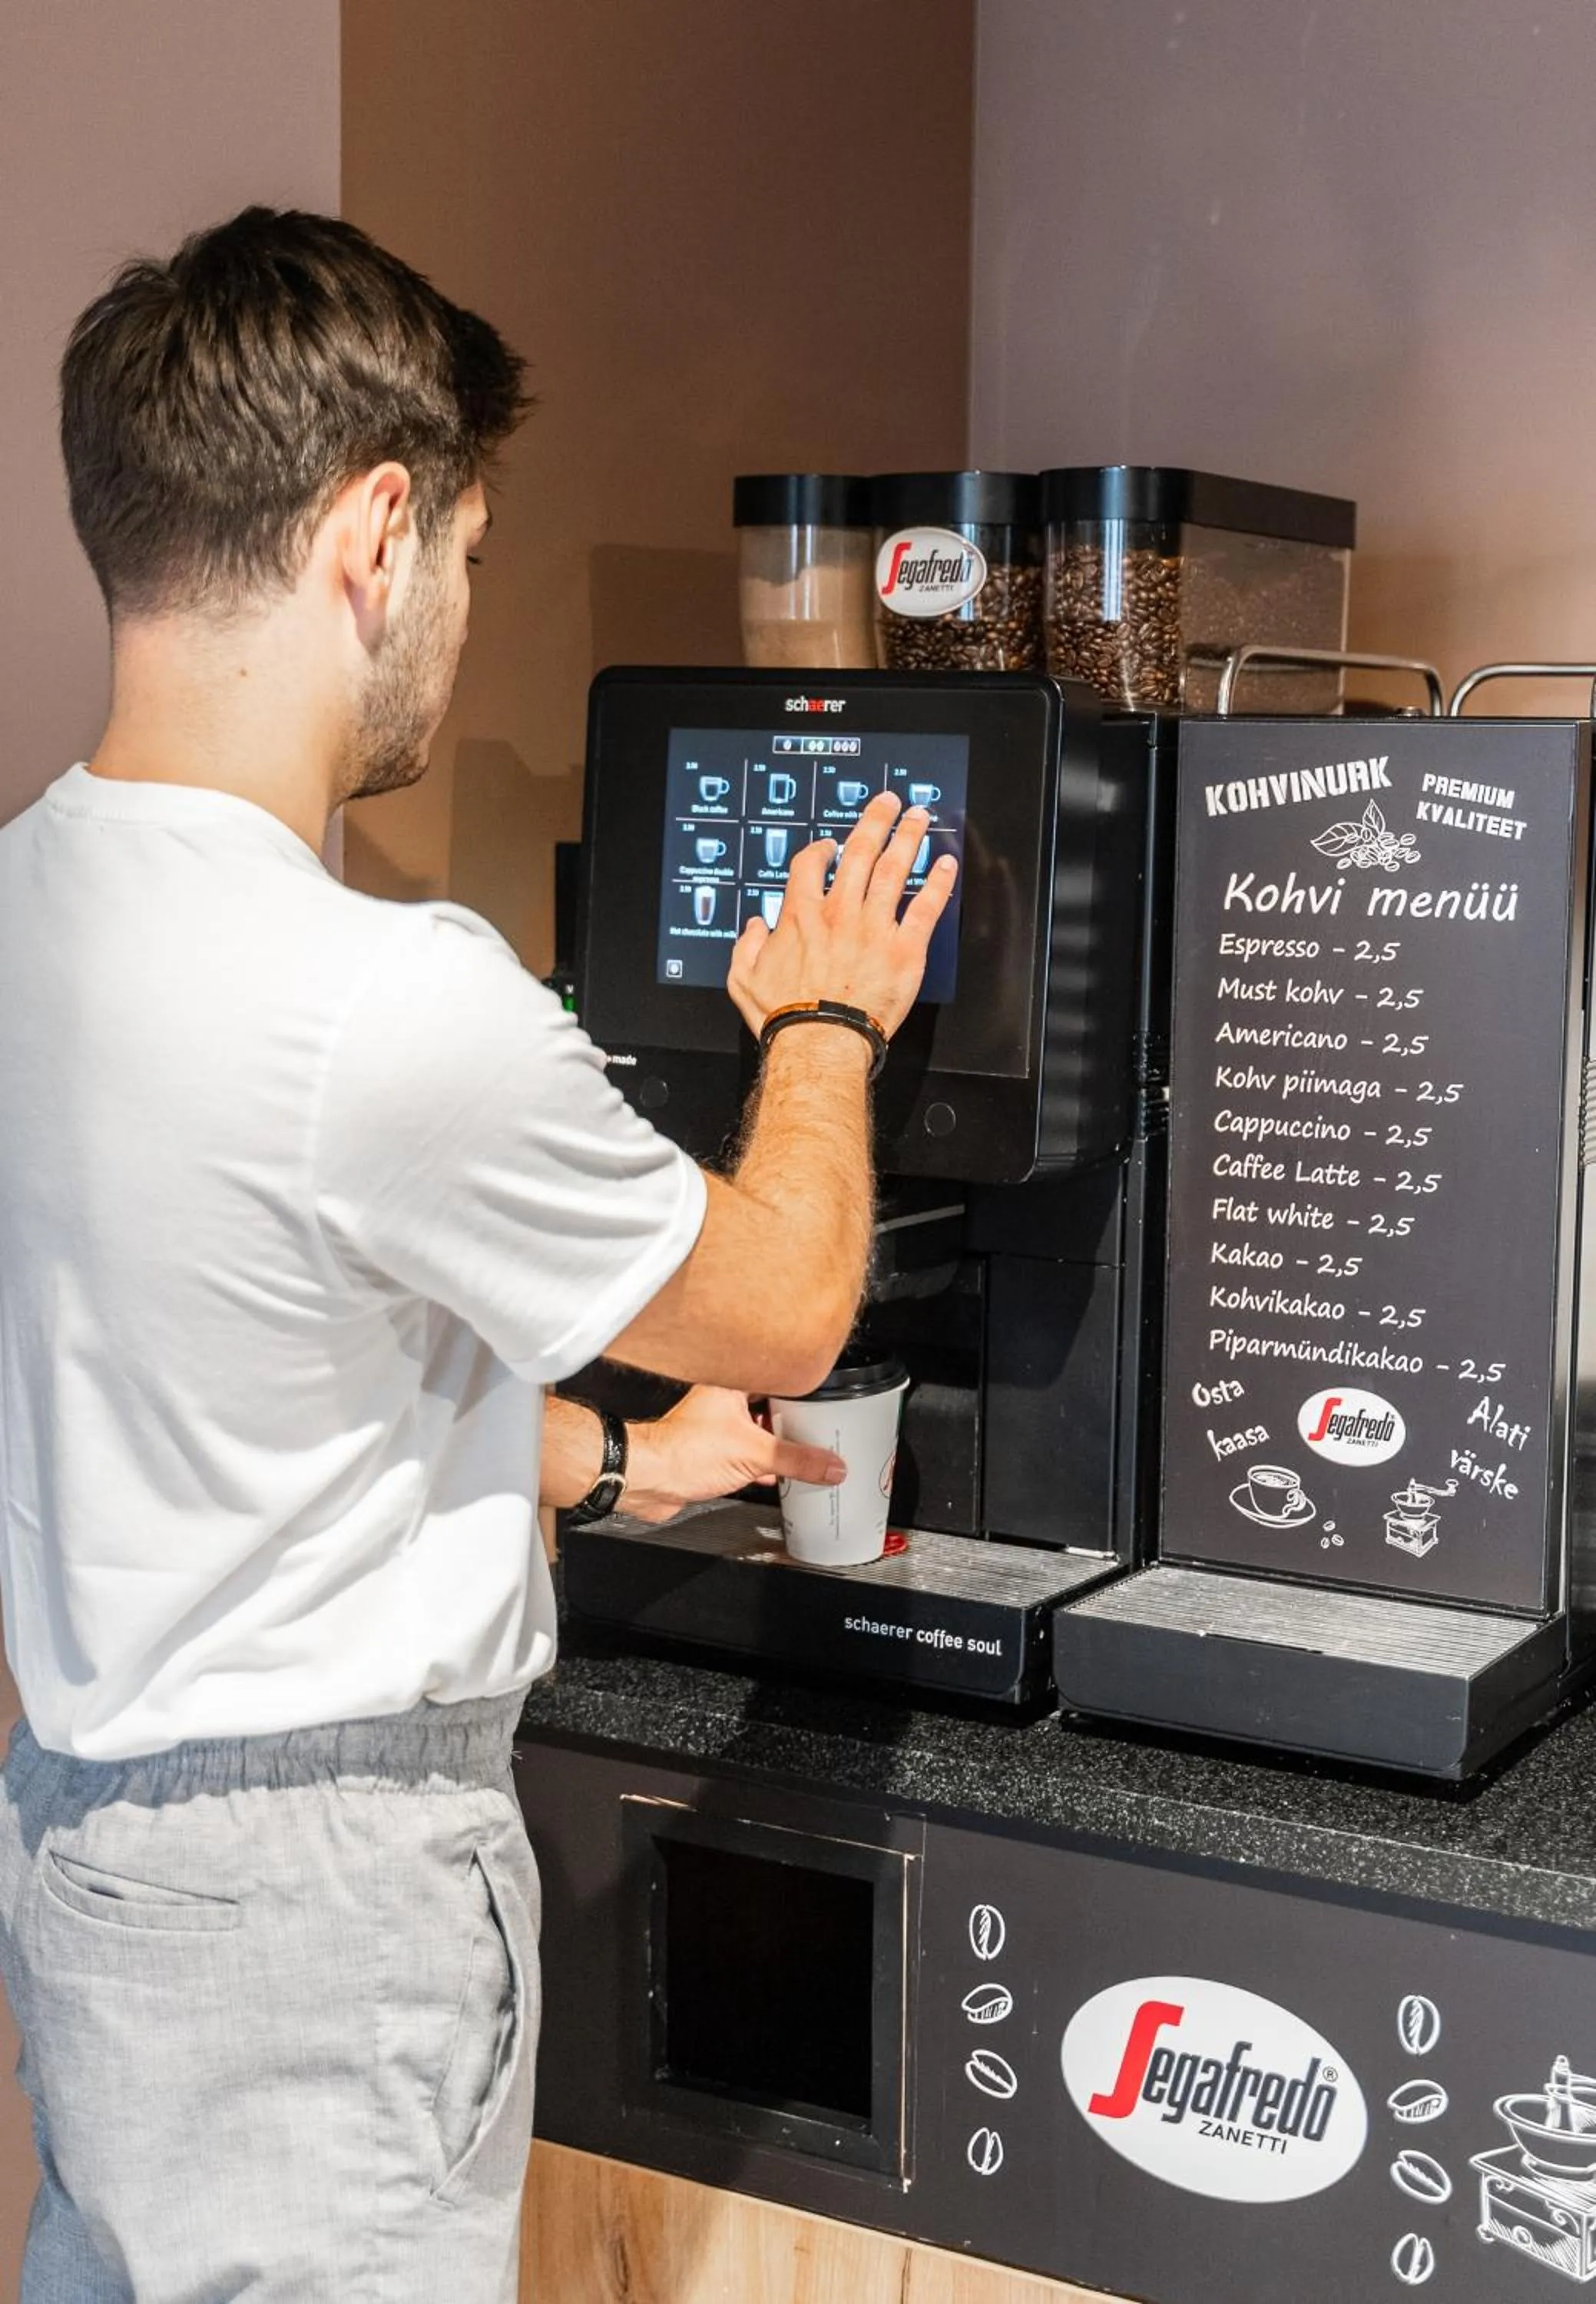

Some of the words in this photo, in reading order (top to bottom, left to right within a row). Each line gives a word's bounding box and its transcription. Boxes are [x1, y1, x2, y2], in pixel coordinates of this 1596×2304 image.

[882, 541, 972, 594] Segafredo
[919, 584, 954, 593] ZANETTI
[785, 695, 846, 713] schaerer
[1205, 755, 1392, 816] KOHVINURK
[1422, 773, 1515, 809] PREMIUM
[1416, 800, 1528, 841] KVALITEET
[1224, 872, 1346, 915] Kohvi
[1366, 882, 1519, 922] menüü
[1220, 933, 1320, 963] Espresso
[1353, 940, 1402, 964] 2,5
[1217, 977, 1277, 1001] Must
[1285, 978, 1345, 1005] kohv
[1376, 987, 1425, 1011] 2,5
[1215, 1021, 1348, 1051] Americano
[1382, 1033, 1429, 1057] 2,5
[612, 1054, 637, 1066] made
[1216, 1065, 1276, 1091] Kohv
[1282, 1069, 1381, 1104] piimaga
[1416, 1081, 1465, 1105] 2,5
[1214, 1109, 1351, 1143] Cappuccino
[1385, 1124, 1432, 1148] 2,5
[1213, 1153, 1286, 1180] Caffee
[1295, 1160, 1360, 1187] Latte
[1395, 1170, 1442, 1195] 2,5
[1212, 1196, 1260, 1223] Flat
[1267, 1202, 1334, 1230] white
[1368, 1213, 1416, 1238] 2,5
[1210, 1242, 1283, 1269] Kakao
[1316, 1253, 1363, 1278] 2,5
[1210, 1286, 1346, 1320] Kohvikakao
[1379, 1305, 1426, 1329] 2,5
[1210, 1329, 1423, 1373] Piparmündikakao
[1458, 1359, 1506, 1383] 2,5
[1191, 1380, 1245, 1407] Osta
[1307, 1397, 1396, 1442] Segafredo
[1466, 1395, 1531, 1451] Alati
[1207, 1425, 1270, 1462] kaasa
[1346, 1437, 1379, 1448] ZANETTI
[1450, 1449, 1519, 1500] värske
[845, 1616, 913, 1640] schaerer
[916, 1628, 963, 1650] coffee
[967, 1638, 1002, 1657] soul
[1198, 2120, 1288, 2155] ZANETTI
